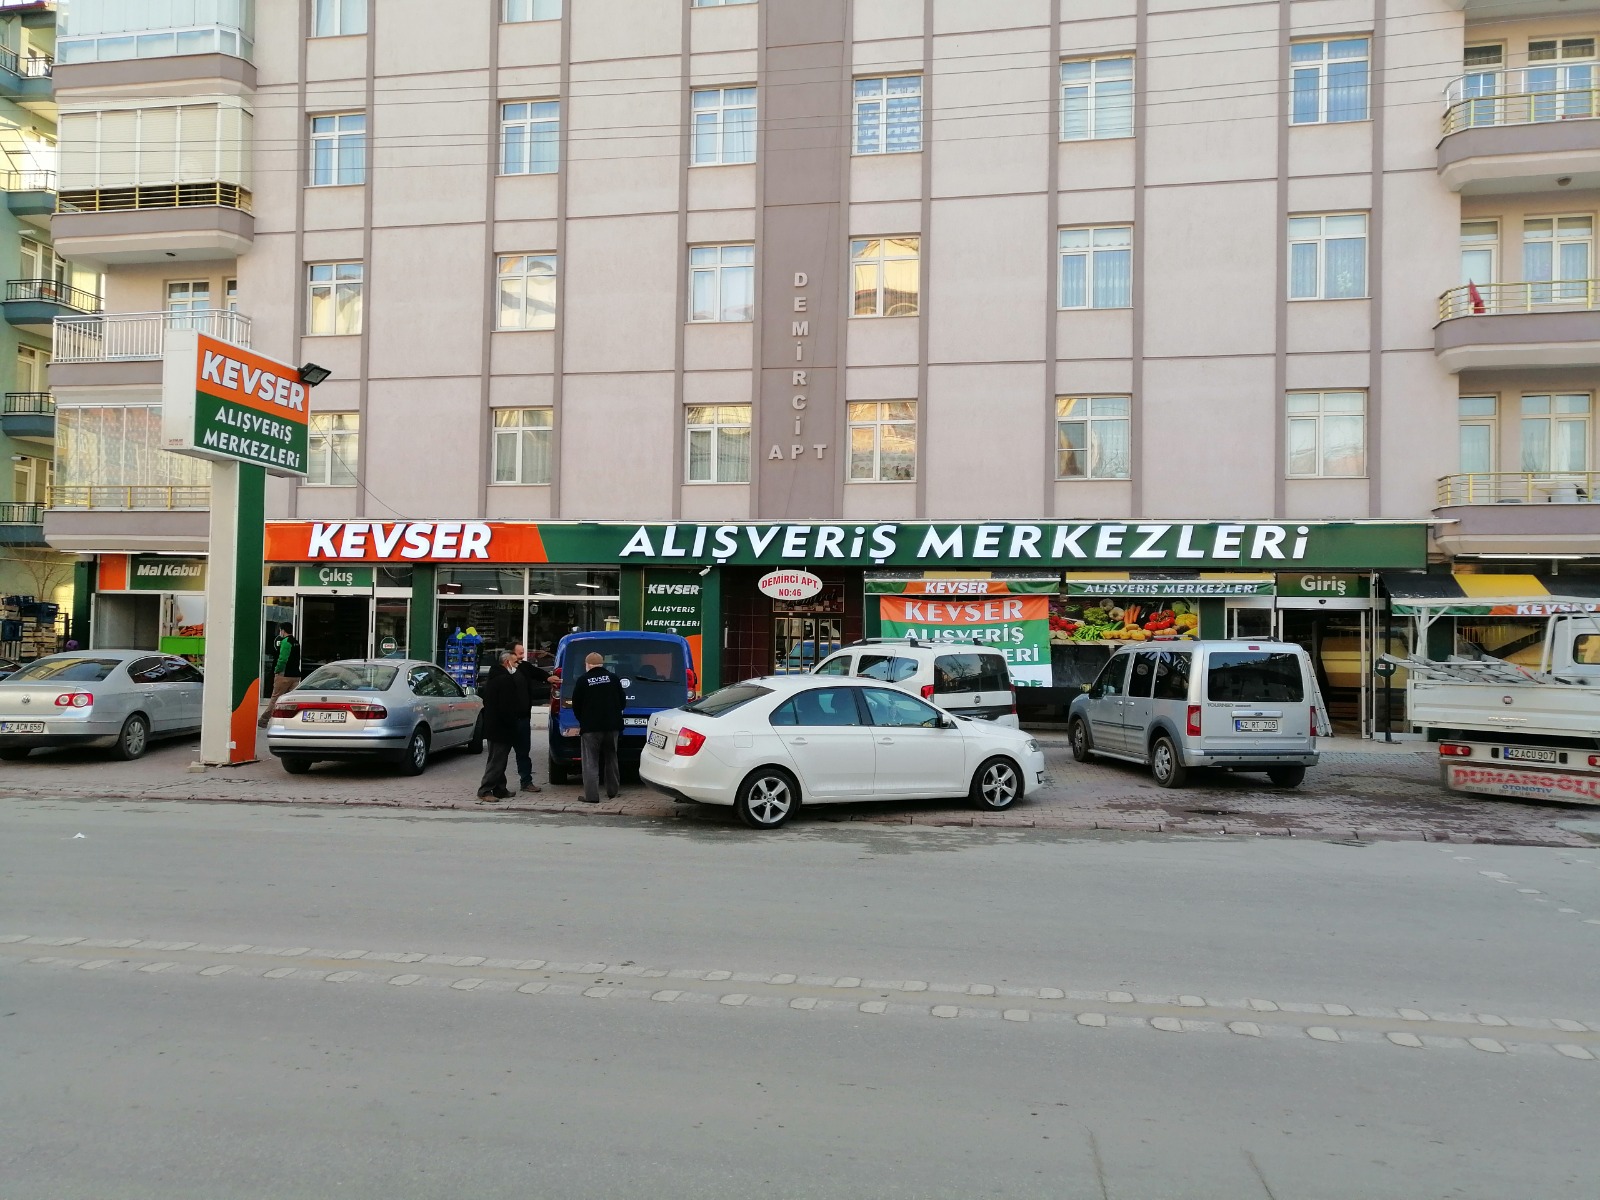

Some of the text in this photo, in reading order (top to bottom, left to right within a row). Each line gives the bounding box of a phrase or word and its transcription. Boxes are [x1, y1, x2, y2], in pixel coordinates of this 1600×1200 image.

[201, 349, 305, 412] KEVSER
[308, 522, 492, 559] KEVSER
[137, 564, 202, 576] Mal Kabul
[319, 568, 353, 587] Çıkış
[801, 576, 819, 590] APT.
[647, 584, 700, 595] KEVSER
[925, 582, 988, 594] KEVSER
[1300, 575, 1347, 596] Giriş
[779, 589, 802, 597] NO:46
[905, 600, 1024, 622] KEVSER
[307, 711, 315, 720] 42
[1240, 721, 1248, 729] 42
[1252, 721, 1260, 729] RT
[1509, 750, 1554, 760] 42 ACU 907
